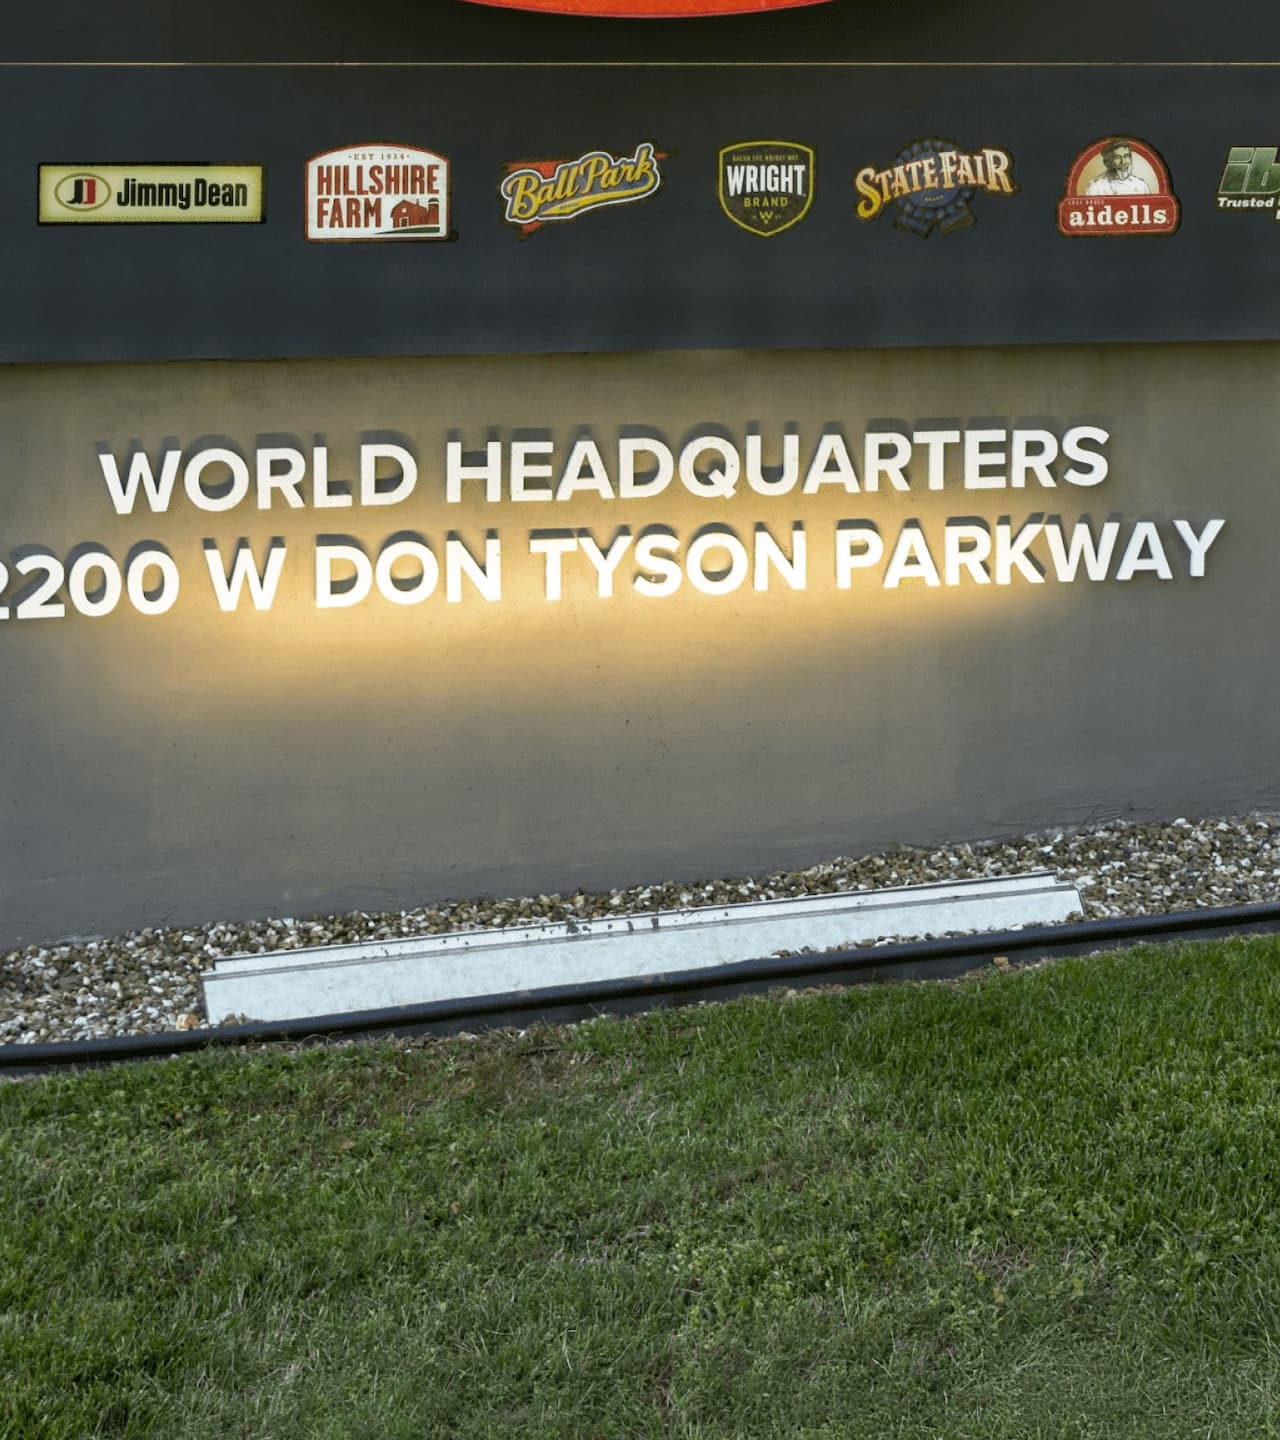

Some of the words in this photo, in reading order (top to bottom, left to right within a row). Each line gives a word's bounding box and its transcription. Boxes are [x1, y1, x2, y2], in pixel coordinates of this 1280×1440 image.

[116, 178, 192, 210] Jimmy
[194, 178, 248, 207] Dean
[317, 164, 440, 196] HILLSHIRE
[506, 166, 580, 219] Ball
[579, 148, 656, 196] Park
[726, 164, 806, 197] WRIGHT
[855, 157, 940, 219] STATE
[938, 148, 1014, 193] FAIR
[317, 197, 382, 229] FARM
[743, 197, 789, 208] BRAND
[1069, 204, 1168, 227] aidells
[1217, 197, 1276, 209] Trusted
[98, 443, 418, 515] WORLD
[446, 426, 1110, 503] HEADQUARTERS
[204, 547, 287, 612] W
[314, 538, 503, 610] DON
[529, 530, 808, 604] TYSON
[835, 519, 1226, 591] PARKWAY
